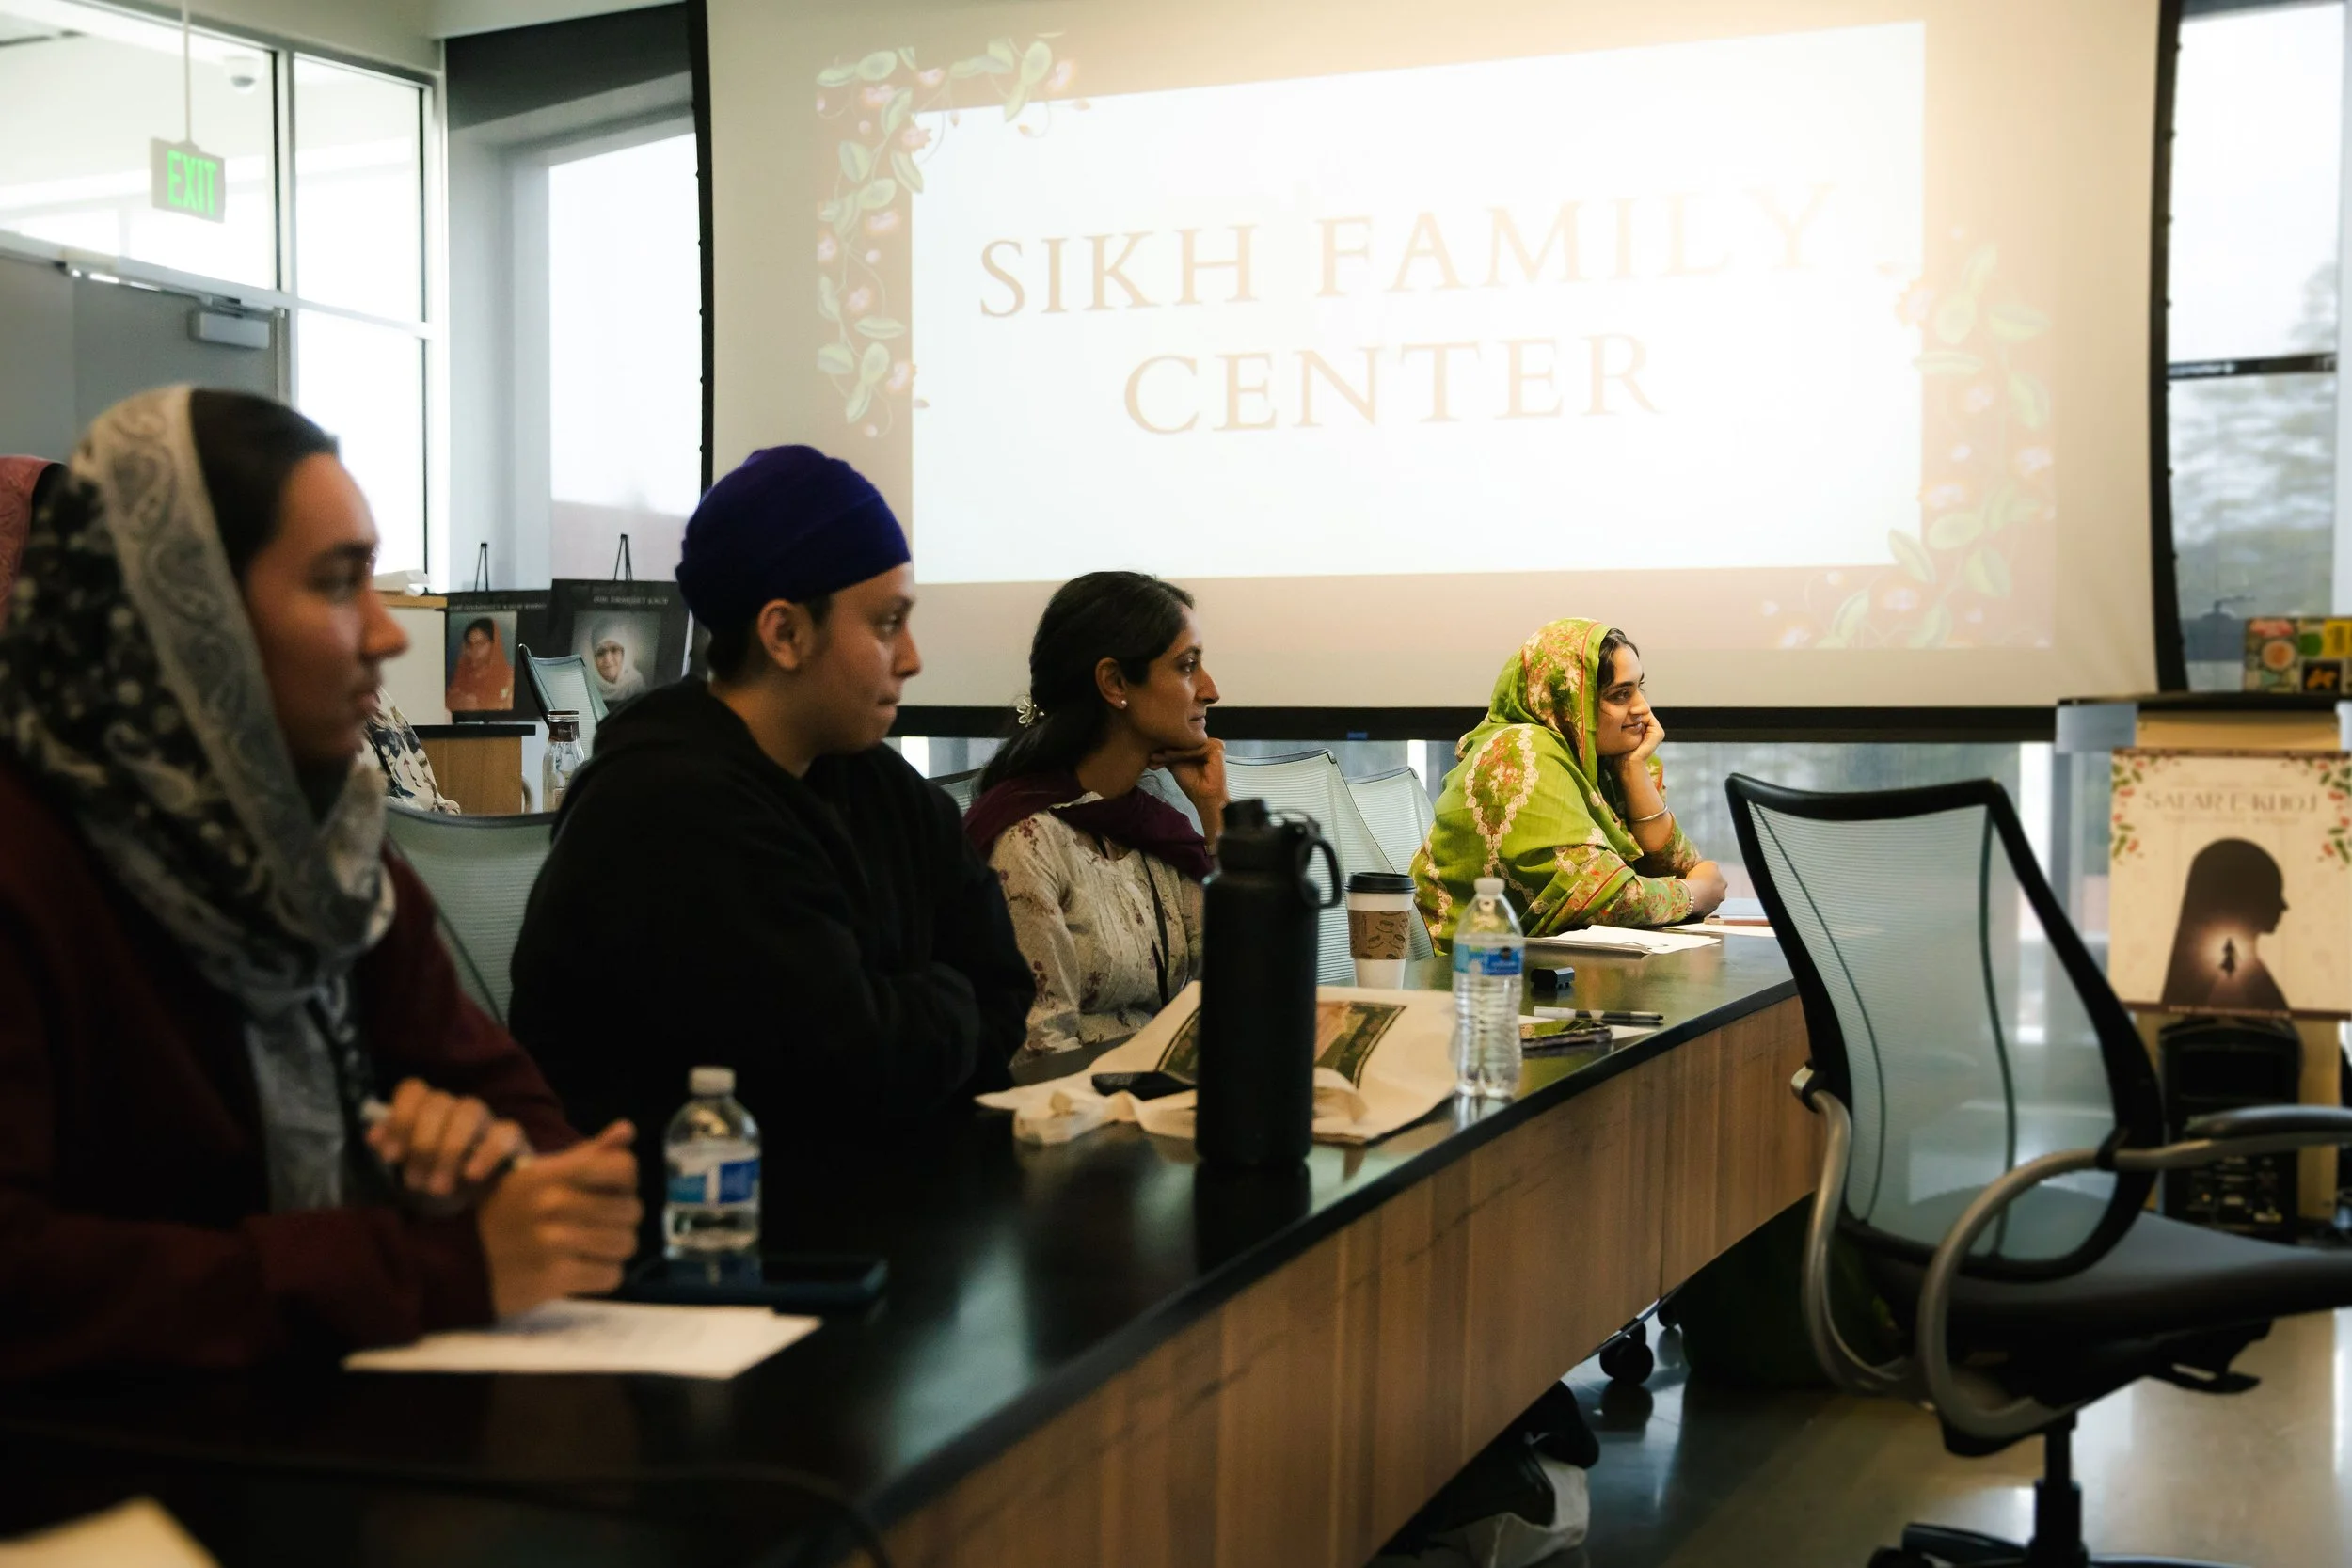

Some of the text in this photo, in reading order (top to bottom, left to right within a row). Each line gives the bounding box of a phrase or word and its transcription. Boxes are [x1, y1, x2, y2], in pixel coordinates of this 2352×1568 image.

[167, 150, 217, 217] EXIT
[977, 181, 1837, 318] SIKH FAMILY
[1122, 330, 1668, 436] CENTER
